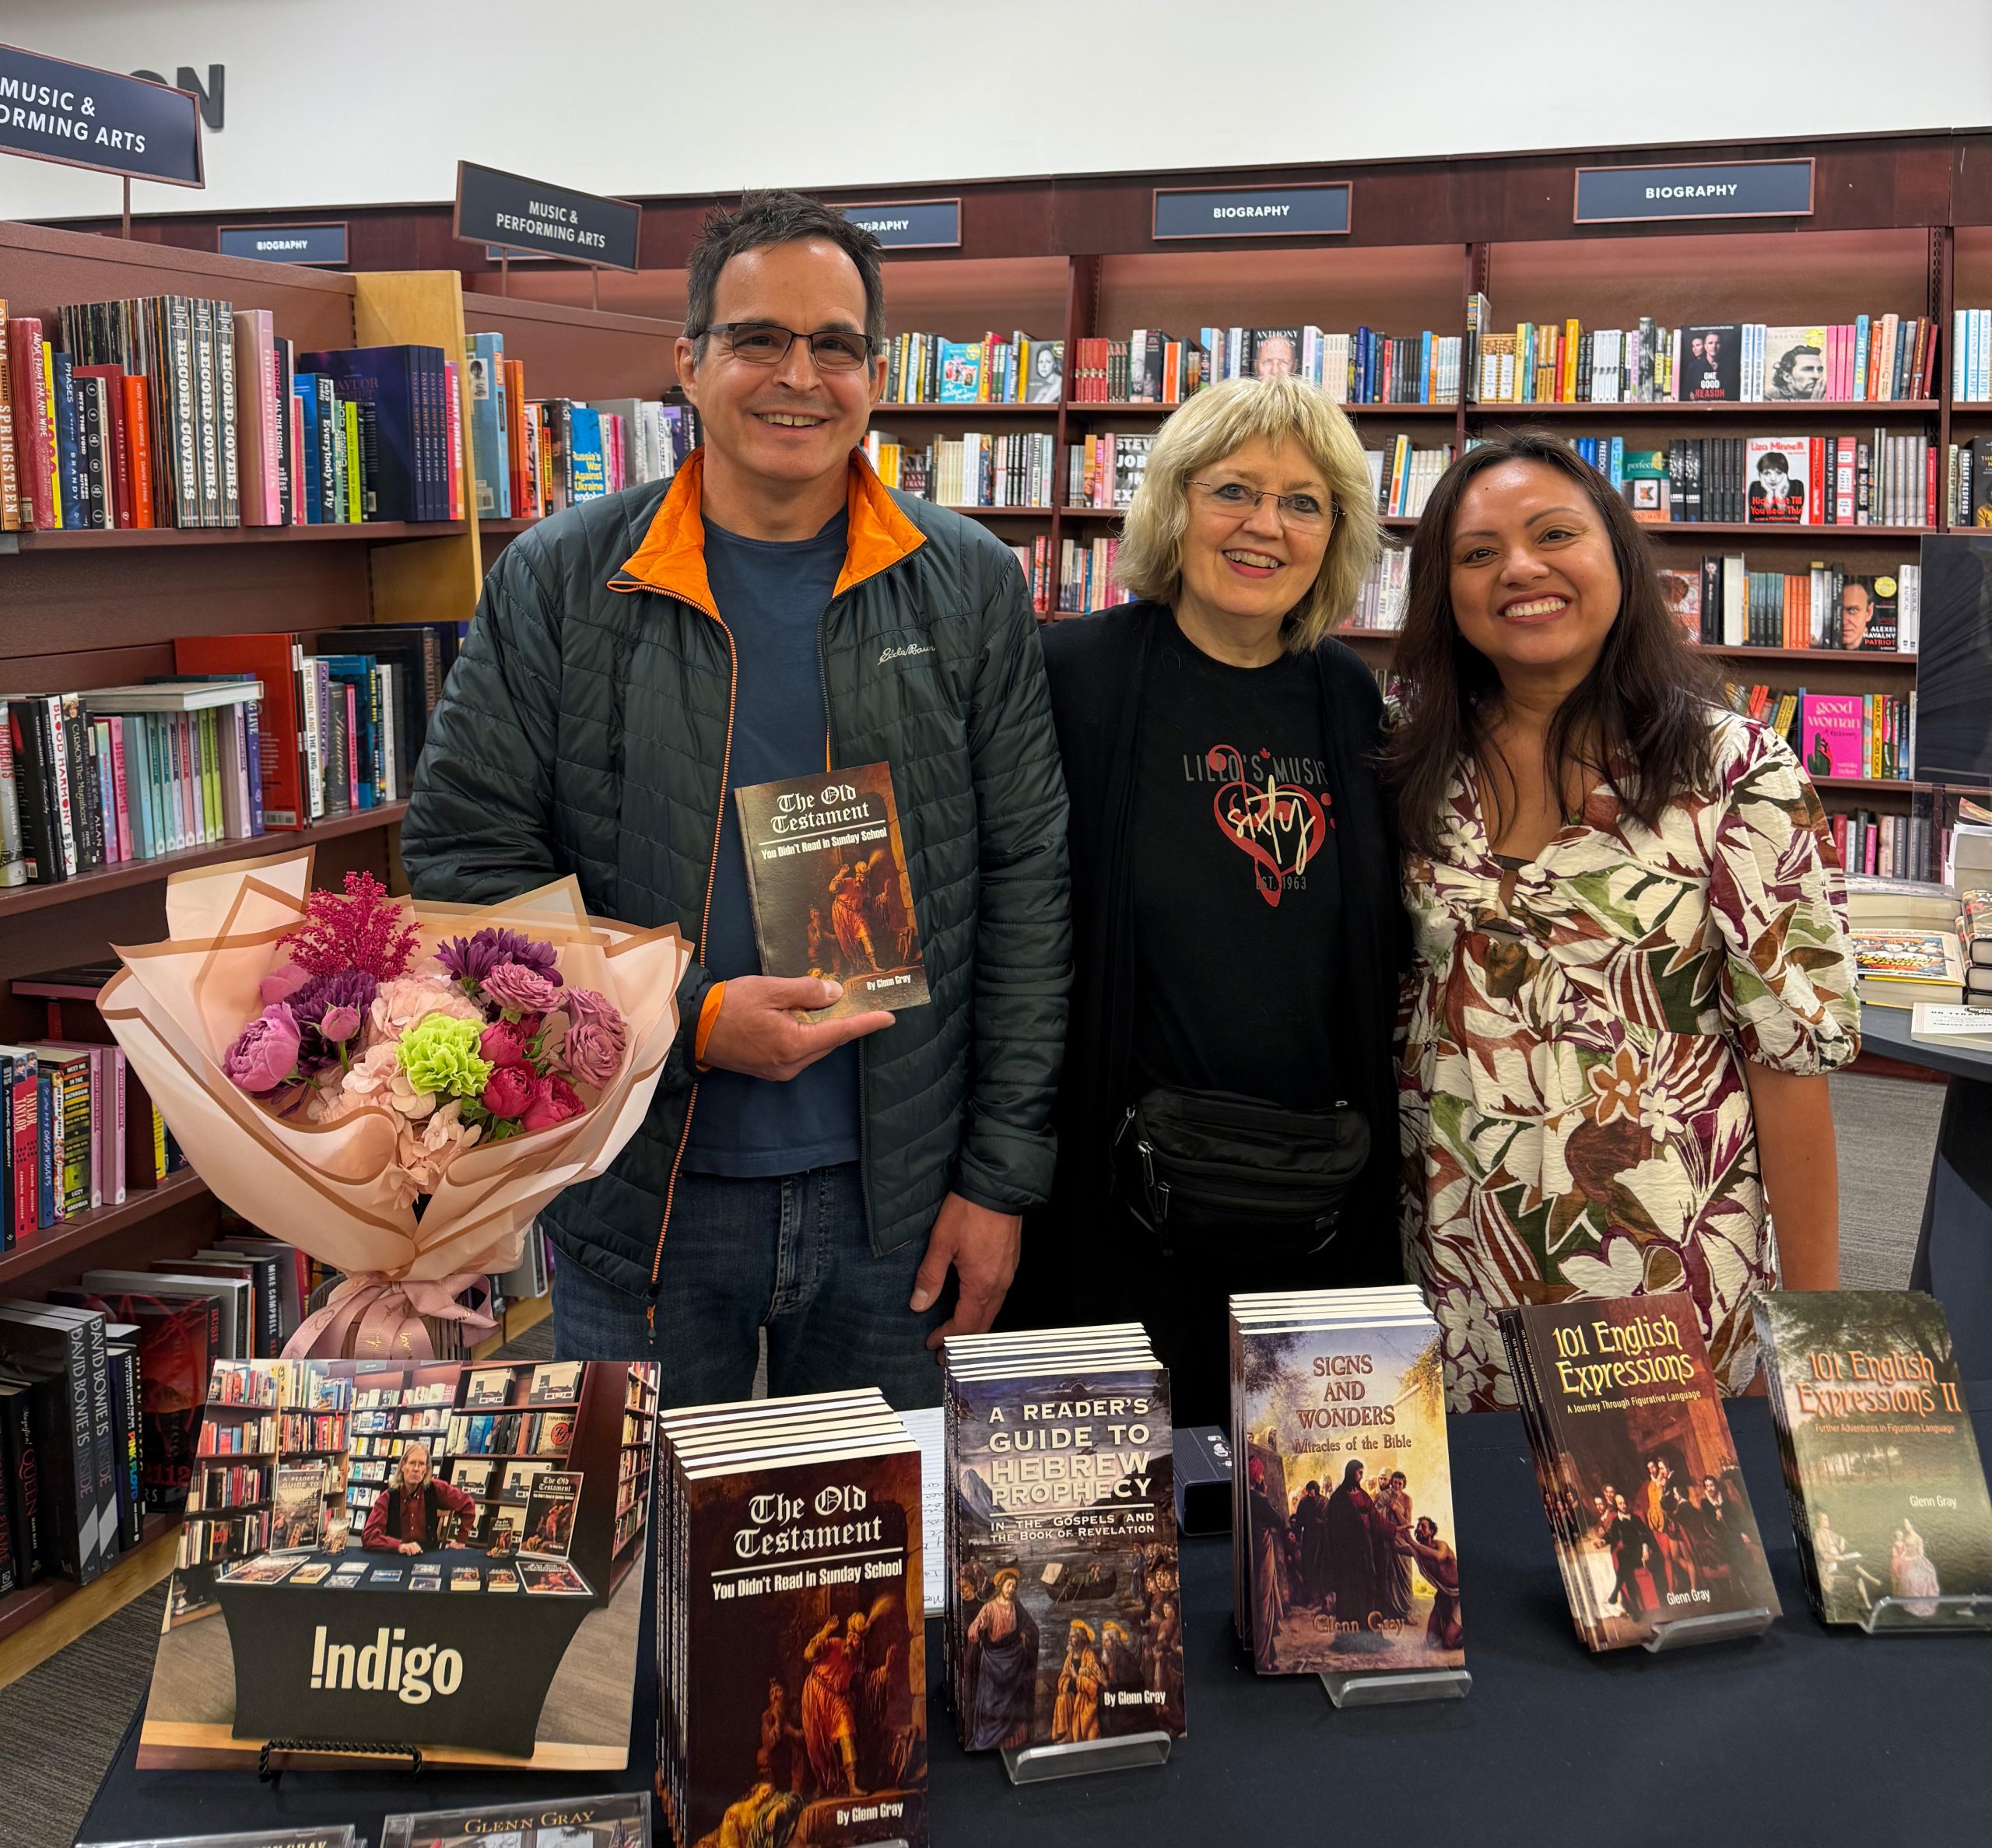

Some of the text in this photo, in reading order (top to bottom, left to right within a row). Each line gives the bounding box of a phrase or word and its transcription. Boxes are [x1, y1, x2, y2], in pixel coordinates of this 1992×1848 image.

[0, 78, 96, 117] MUSIC &
[95, 126, 146, 153] ARTS
[1645, 183, 1738, 199] BIOGRAPHY
[528, 200, 579, 224] MUSIC &
[1212, 205, 1290, 219] BIOGRAPHY
[256, 240, 308, 251] BIOGRAPHY
[496, 212, 606, 248] PERFORMING ARTS
[65, 363, 74, 404] PHASES
[177, 339, 191, 419] RECORD
[200, 342, 214, 420] RECORD
[1700, 380, 1720, 389] GOOD
[1703, 372, 1717, 380] ONE
[1695, 389, 1725, 398] REASON
[0, 405, 17, 514] SPRINGSTEEN
[454, 422, 462, 469] DREAMS
[1751, 441, 1804, 451] Liza Minnelli
[70, 451, 79, 500] BRANDY
[181, 423, 195, 500] COVERS
[203, 423, 217, 500] COVERS
[323, 419, 335, 509] Everybody's Fly
[586, 461, 601, 470] War
[574, 481, 604, 491] Ukraine
[1962, 482, 1970, 515] REDFORD
[424, 637, 436, 711] REVOLUTION
[1808, 716, 1860, 728] woman
[1815, 700, 1853, 715] good
[54, 704, 65, 752] BLOOD
[1183, 754, 1264, 782] LILLO'S
[58, 758, 71, 827] HARMONY
[777, 784, 856, 812] The Old
[94, 815, 103, 847] ALAN
[770, 801, 870, 834] Testament
[1227, 774, 1316, 875] sixty
[761, 847, 777, 860] You
[777, 842, 801, 857] Didn't
[801, 840, 821, 854] Read
[831, 833, 860, 848] Sunday
[861, 827, 887, 843] School
[1283, 876, 1306, 890] 1963
[866, 974, 911, 991] By Glenn Gray
[16, 1096, 26, 1133] TAYLOR
[26, 1090, 37, 1126] TAYLOR
[268, 1264, 278, 1335] MIKE CAMPBELL
[1552, 1313, 1683, 1358] 101 English
[1312, 1354, 1373, 1379] SIGNS
[1555, 1350, 1696, 1397] Expressions
[1808, 1350, 1938, 1387] 101 English
[89, 1317, 112, 1488] DAVID BOWIE IS INSIDE
[1323, 1380, 1366, 1403] AND
[1567, 1389, 1701, 1415] A Journey Through Figurative Language
[1797, 1382, 1962, 1415] Expressions II
[71, 1327, 93, 1499] DAVID BOWIE IS INSIDE
[988, 1398, 1150, 1424] A READER'S
[1296, 1404, 1396, 1430] WONDERS
[988, 1423, 1151, 1454] GUIDE TO
[1294, 1432, 1412, 1454] Miracles of the Bible
[1815, 1422, 1955, 1435] Further Adventures in Figurative Language
[128, 1431, 139, 1500] PINK FLOYD
[543, 1476, 570, 1485] The Old
[991, 1450, 1152, 1485] HEBREW
[538, 1483, 571, 1492] Testament
[991, 1477, 1153, 1508] PROPHECY
[1910, 1494, 1957, 1510] Glenn Gray
[749, 1485, 867, 1527] The Old
[733, 1515, 883, 1559] Testament
[991, 1512, 1155, 1532] IN THE GOSPELS AND
[991, 1524, 1156, 1543] THE BOOK OF REVELATION
[713, 1580, 735, 1601] You
[738, 1576, 771, 1597] Didn't
[774, 1573, 803, 1594] Read
[819, 1565, 862, 1589] Sunday
[864, 1558, 903, 1582] School
[1666, 1588, 1710, 1606] Glenn Gray
[1313, 1610, 1405, 1637] Glenn Gray
[1104, 1689, 1166, 1708] By Glenn Gray
[464, 1809, 596, 1836] GLENN GRAY
[836, 1801, 904, 1826] By Glenn Gray
